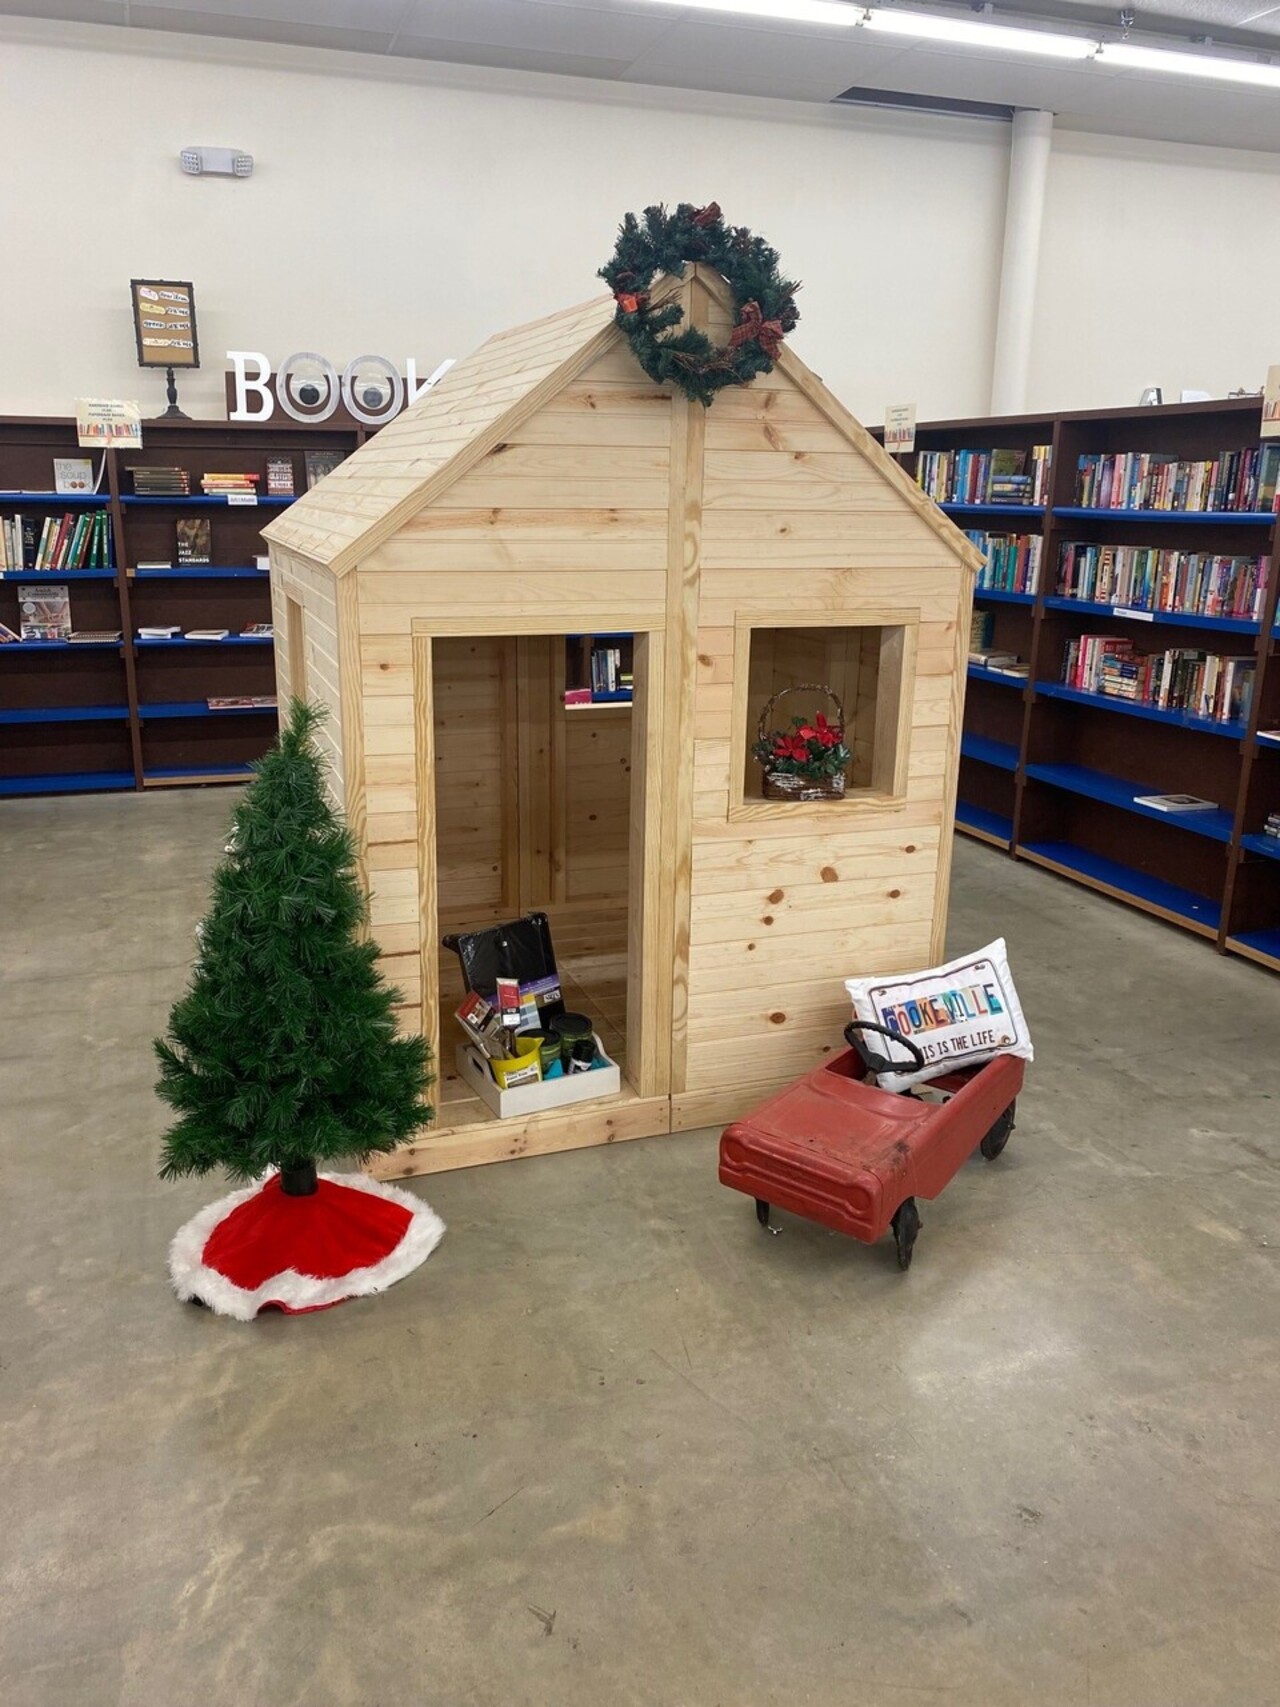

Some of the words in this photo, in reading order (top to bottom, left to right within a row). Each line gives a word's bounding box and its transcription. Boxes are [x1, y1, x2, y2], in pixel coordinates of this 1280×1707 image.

[226, 351, 457, 425] BOOK
[60, 470, 87, 481] soup
[63, 480, 93, 490] book
[882, 983, 1003, 1035] COOKEVILLE
[936, 1041, 949, 1054] IS
[950, 1035, 969, 1051] THE
[969, 1029, 996, 1047] LIFE
